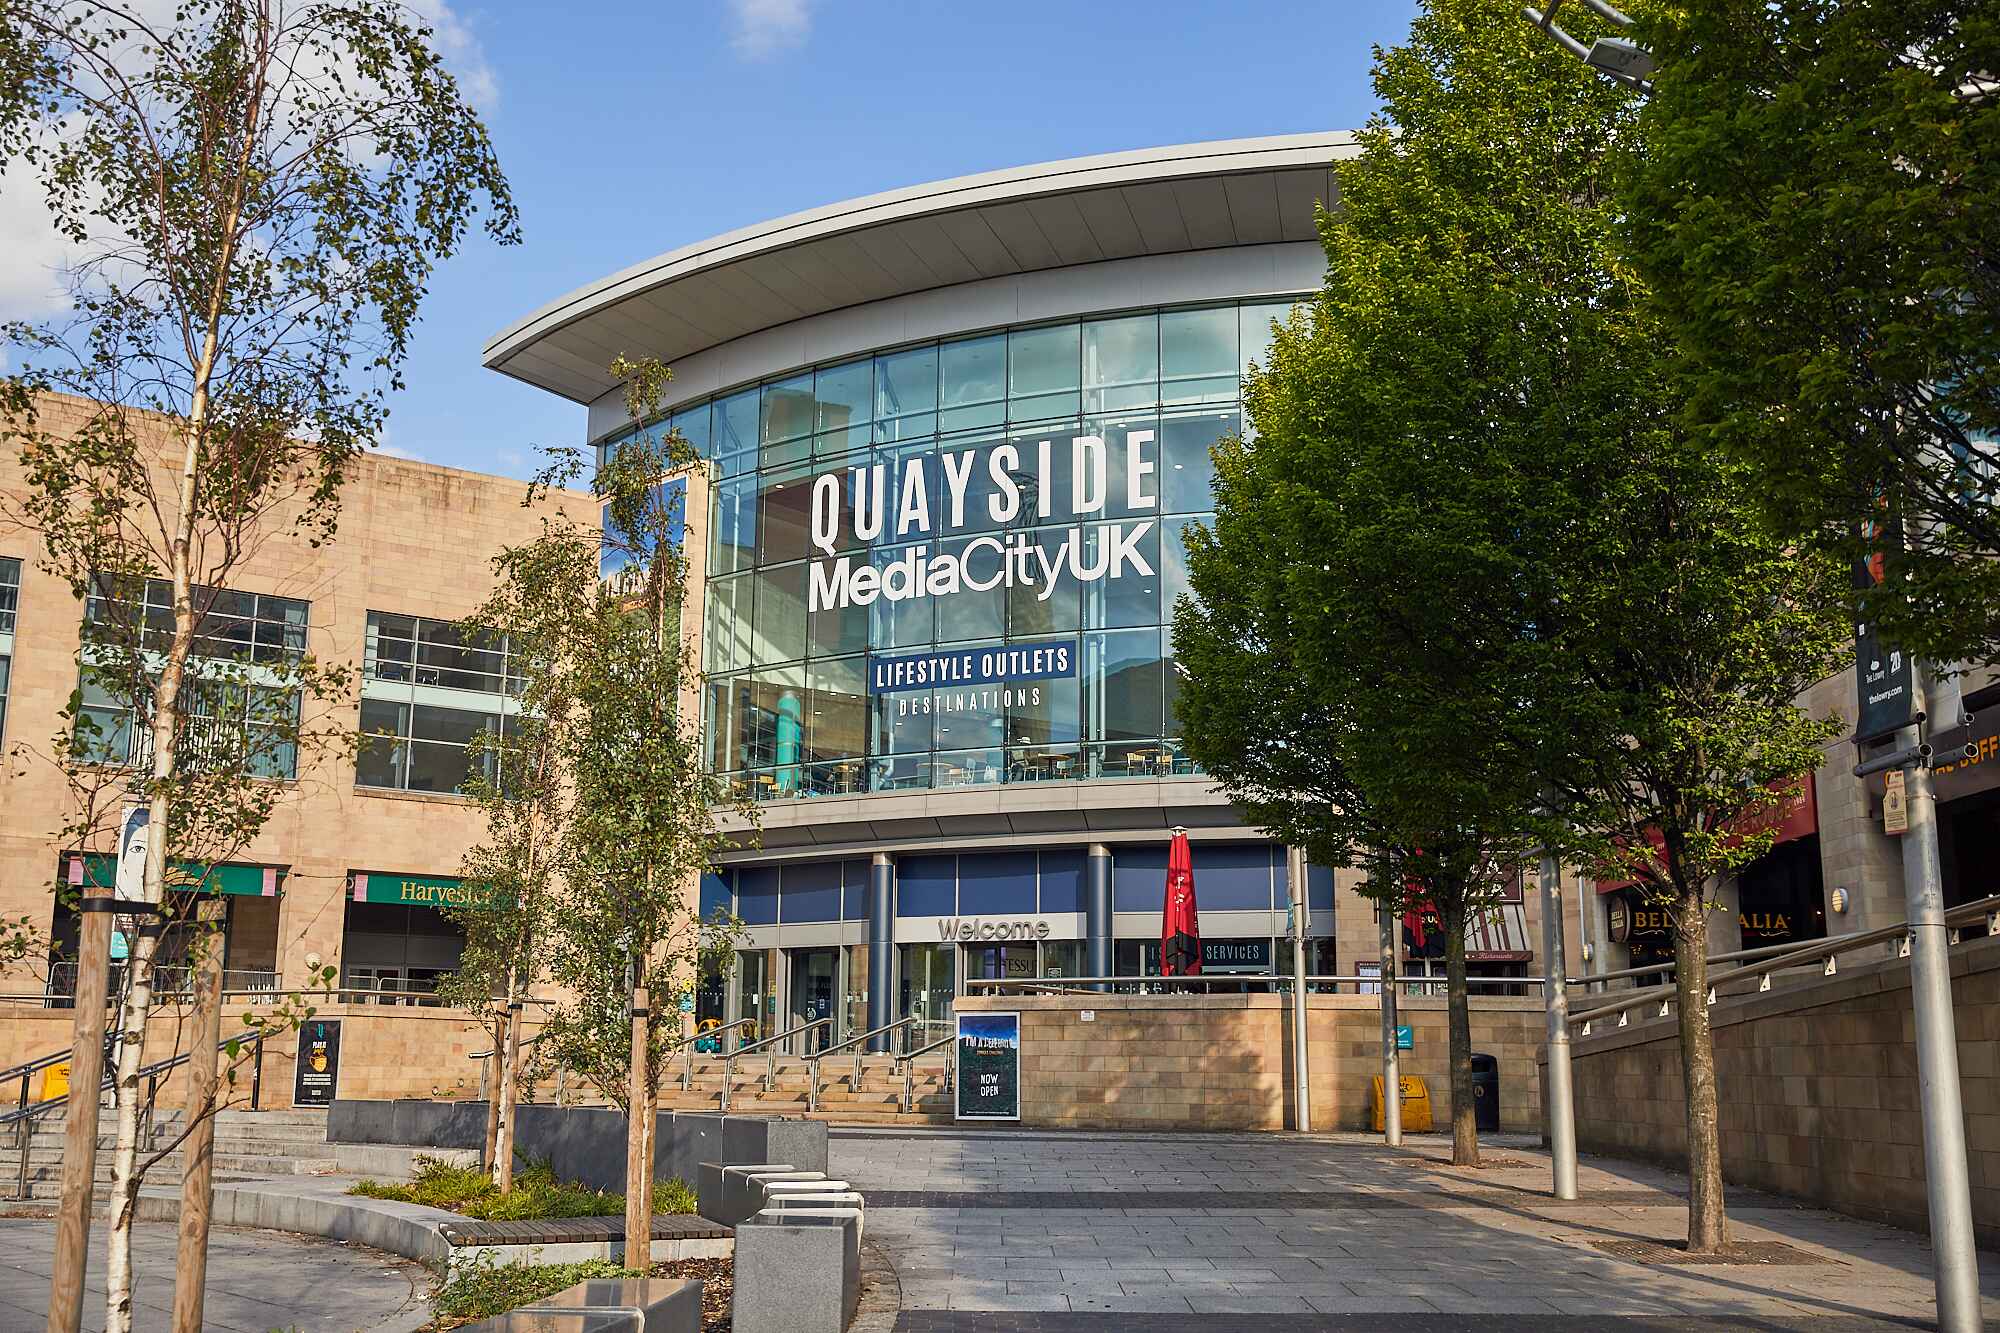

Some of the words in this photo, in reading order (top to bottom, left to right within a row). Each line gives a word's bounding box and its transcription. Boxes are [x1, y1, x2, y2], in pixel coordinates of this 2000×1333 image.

[812, 430, 1155, 557] QUAYSIDE
[809, 522, 1155, 613] MediaCityUK
[876, 654, 972, 688] LIFESTYLE
[981, 647, 1068, 678] OUTLETS
[900, 687, 1041, 717] DESTINATIONS
[1868, 685, 1902, 704] thelowry.com
[938, 918, 1050, 941] Welcome
[1635, 911, 1673, 928] BEL
[1738, 912, 1788, 929] ALIA
[1206, 944, 1260, 961] SERVICES
[980, 1073, 999, 1085] NOW
[980, 1085, 999, 1097] OPEN
